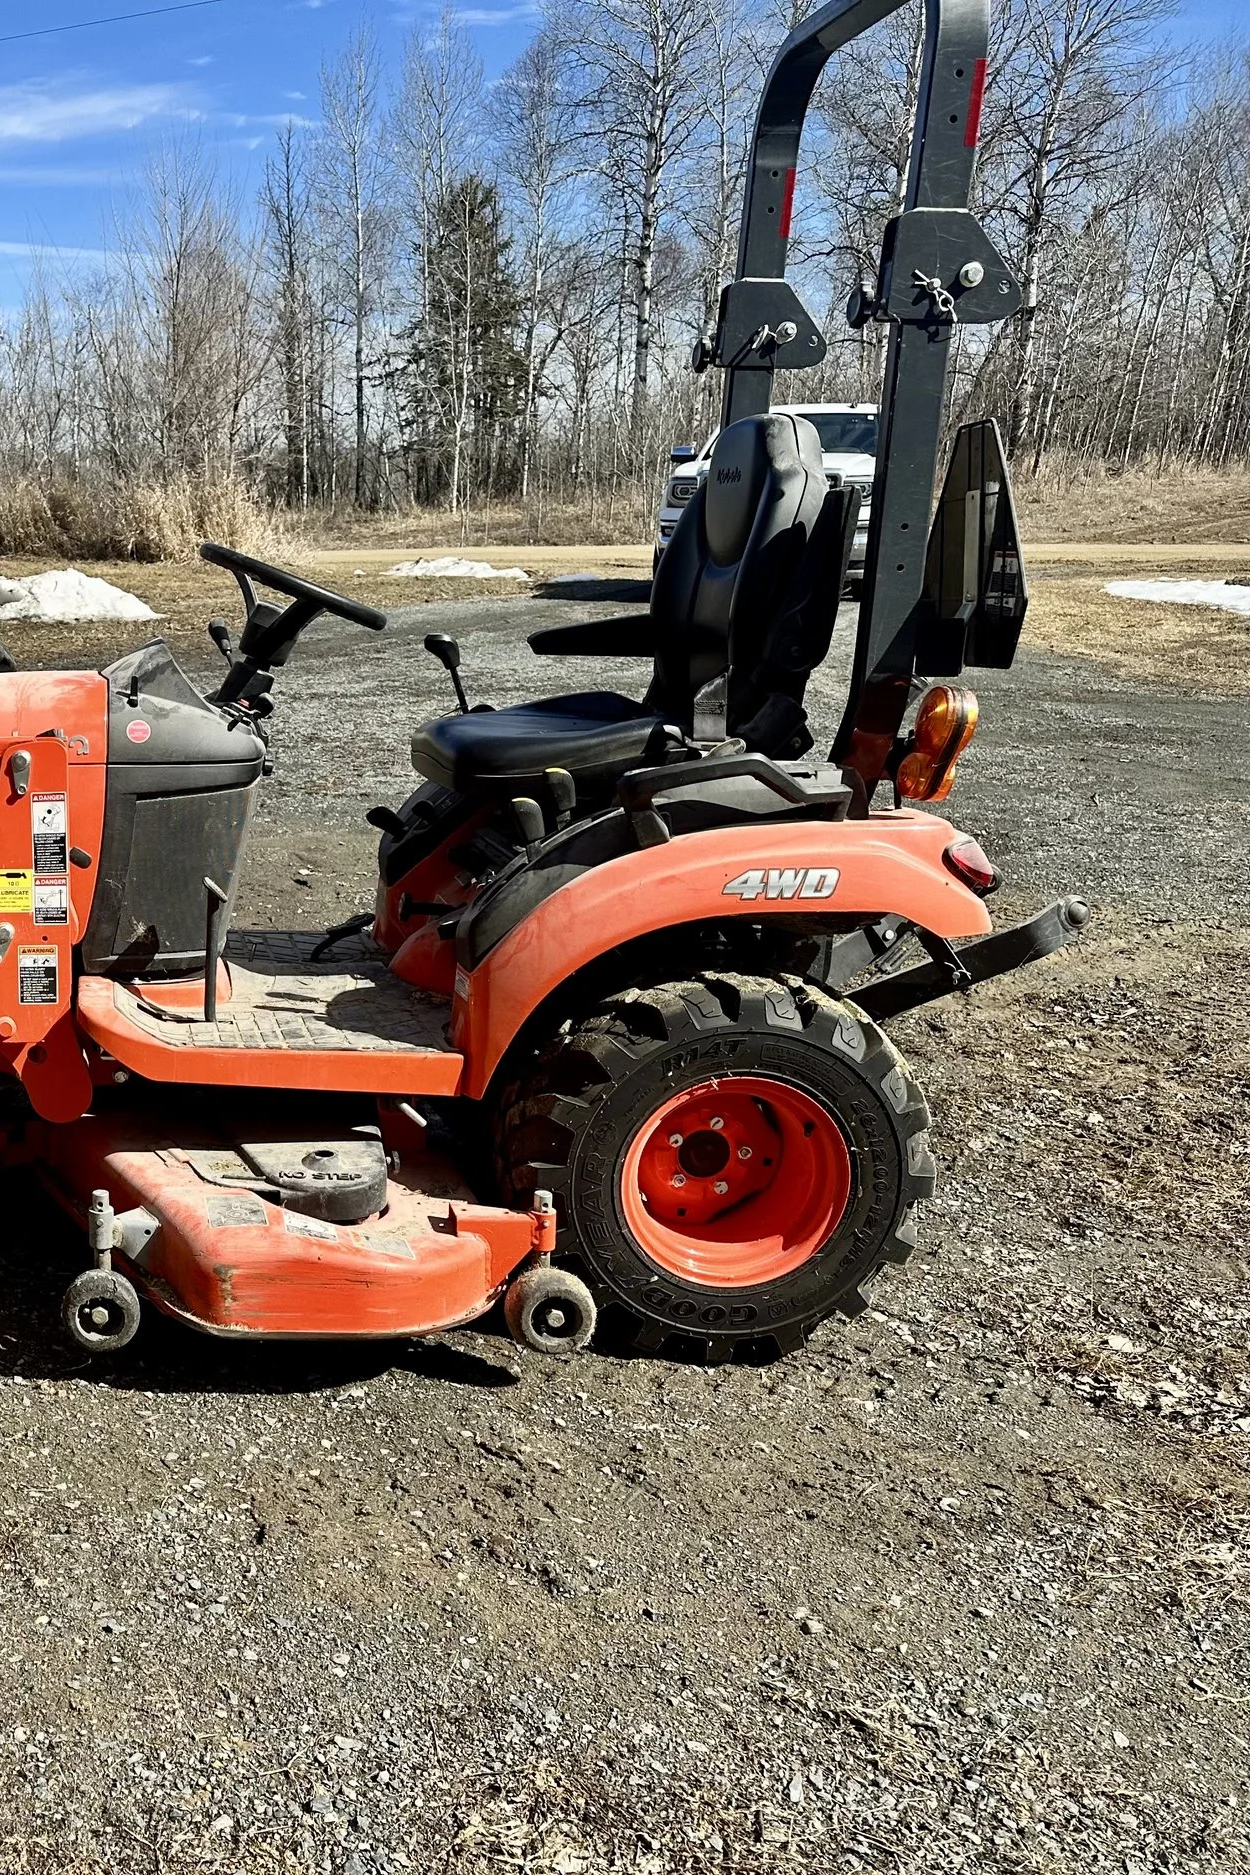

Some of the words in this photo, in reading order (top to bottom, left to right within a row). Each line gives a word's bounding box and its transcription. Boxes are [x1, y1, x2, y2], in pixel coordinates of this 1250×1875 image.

[723, 867, 840, 900] 4WD
[278, 1169, 306, 1180] NO
[312, 1171, 362, 1181] STEP
